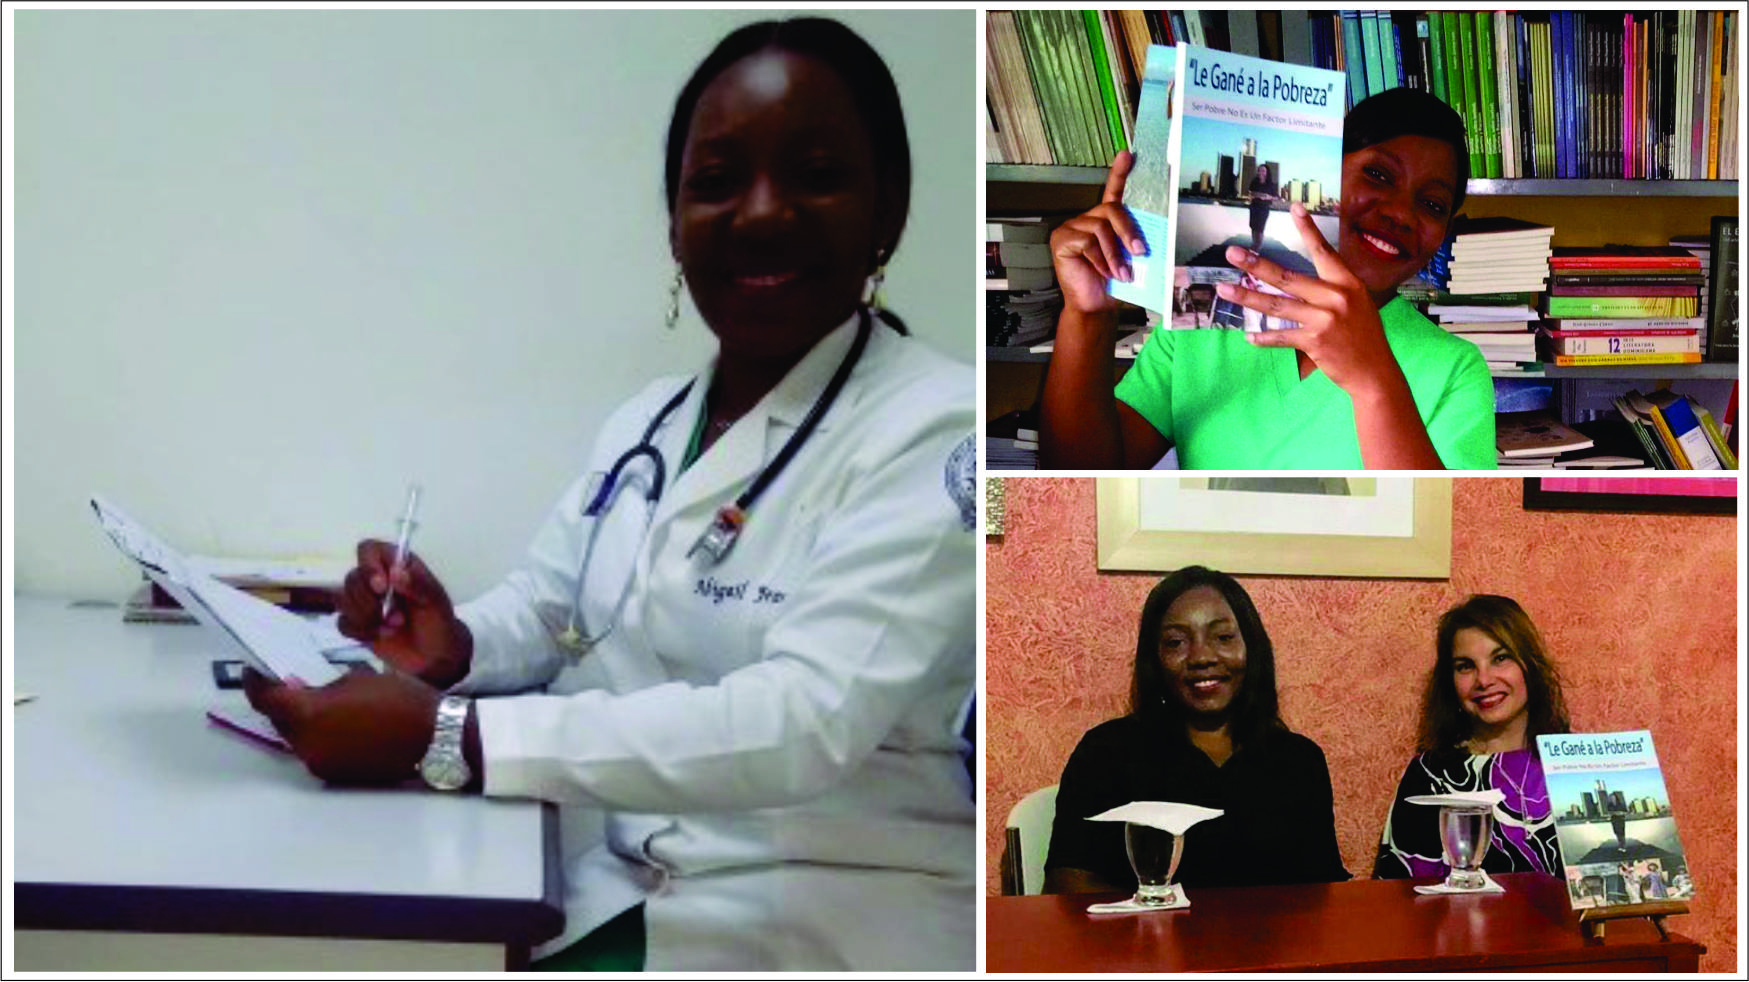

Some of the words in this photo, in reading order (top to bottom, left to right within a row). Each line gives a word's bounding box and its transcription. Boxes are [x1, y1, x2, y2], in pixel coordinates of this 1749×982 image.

[1189, 58, 1208, 87] "Le
[1211, 63, 1245, 94] Gané
[1247, 76, 1255, 96] a
[1259, 71, 1269, 98] la
[1273, 75, 1334, 107] Pobreza"
[1227, 107, 1239, 117] No
[1608, 338, 1621, 354] 12
[1561, 740, 1587, 756] Gané
[1587, 744, 1593, 756] a
[1594, 740, 1604, 756] la
[1604, 737, 1644, 755] Pobreza"
